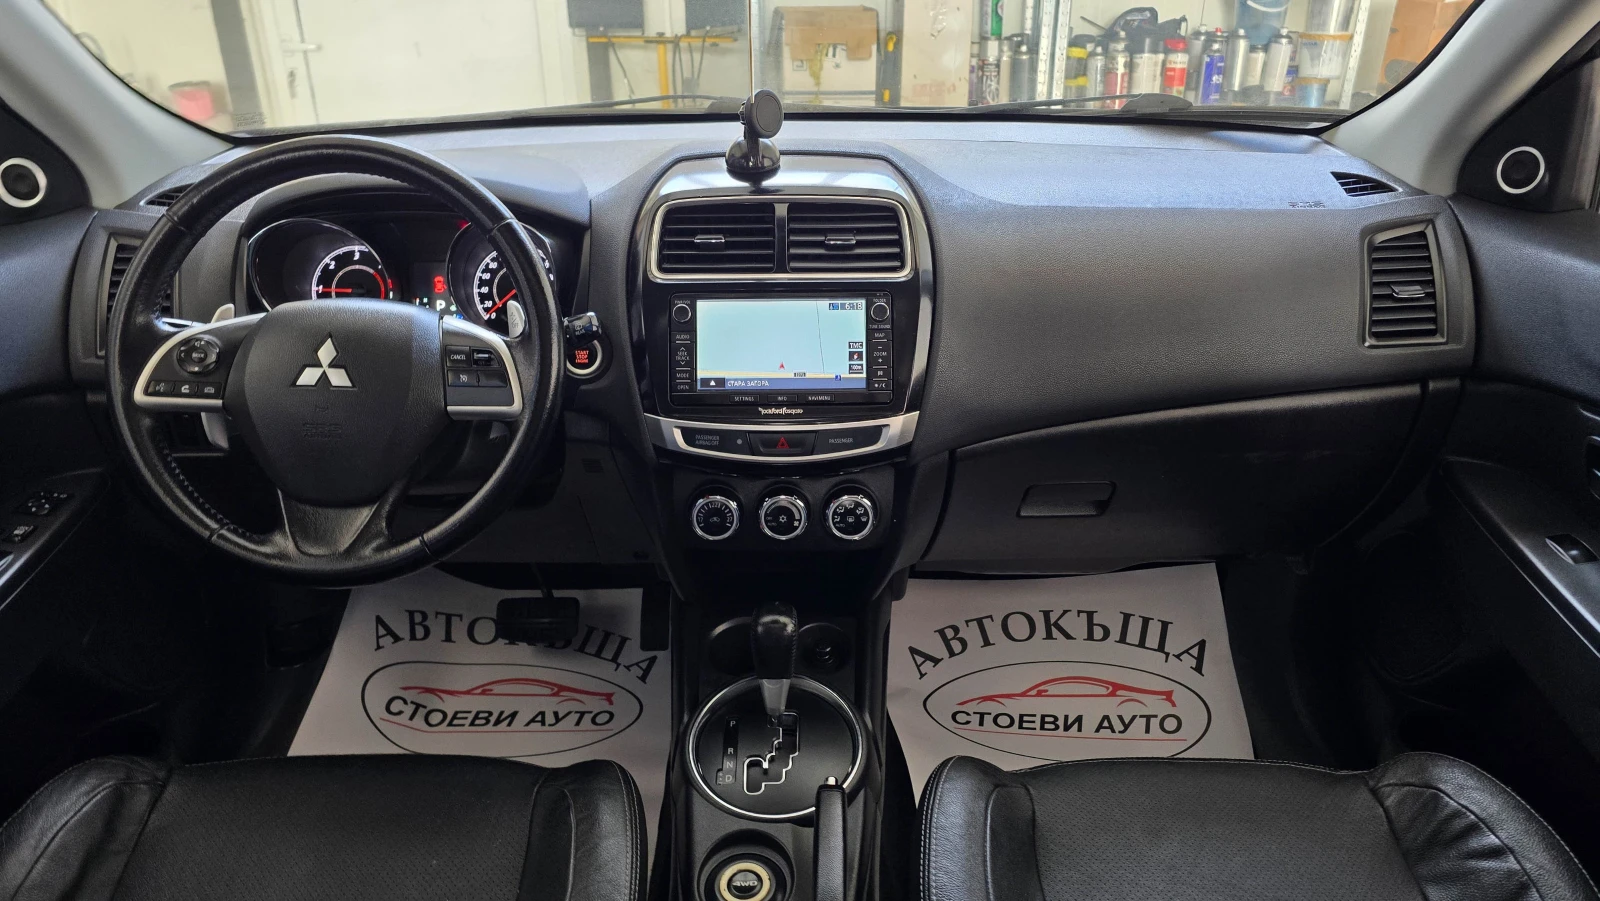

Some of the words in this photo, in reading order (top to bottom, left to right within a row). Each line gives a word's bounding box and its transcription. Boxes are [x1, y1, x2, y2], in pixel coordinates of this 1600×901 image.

[329, 261, 336, 270] 2
[479, 286, 489, 294] 40
[436, 300, 446, 311] P
[845, 302, 863, 310] 6:18
[374, 609, 658, 685] АВТОЩА
[907, 608, 1207, 680] АВТОКЪЩА
[385, 696, 519, 728] СТОЕВИ
[524, 709, 615, 728] АУТО
[951, 710, 1083, 734] СТОЕВИ
[1094, 713, 1183, 735] АУТО
[726, 761, 733, 769] N
[725, 774, 733, 782] D
